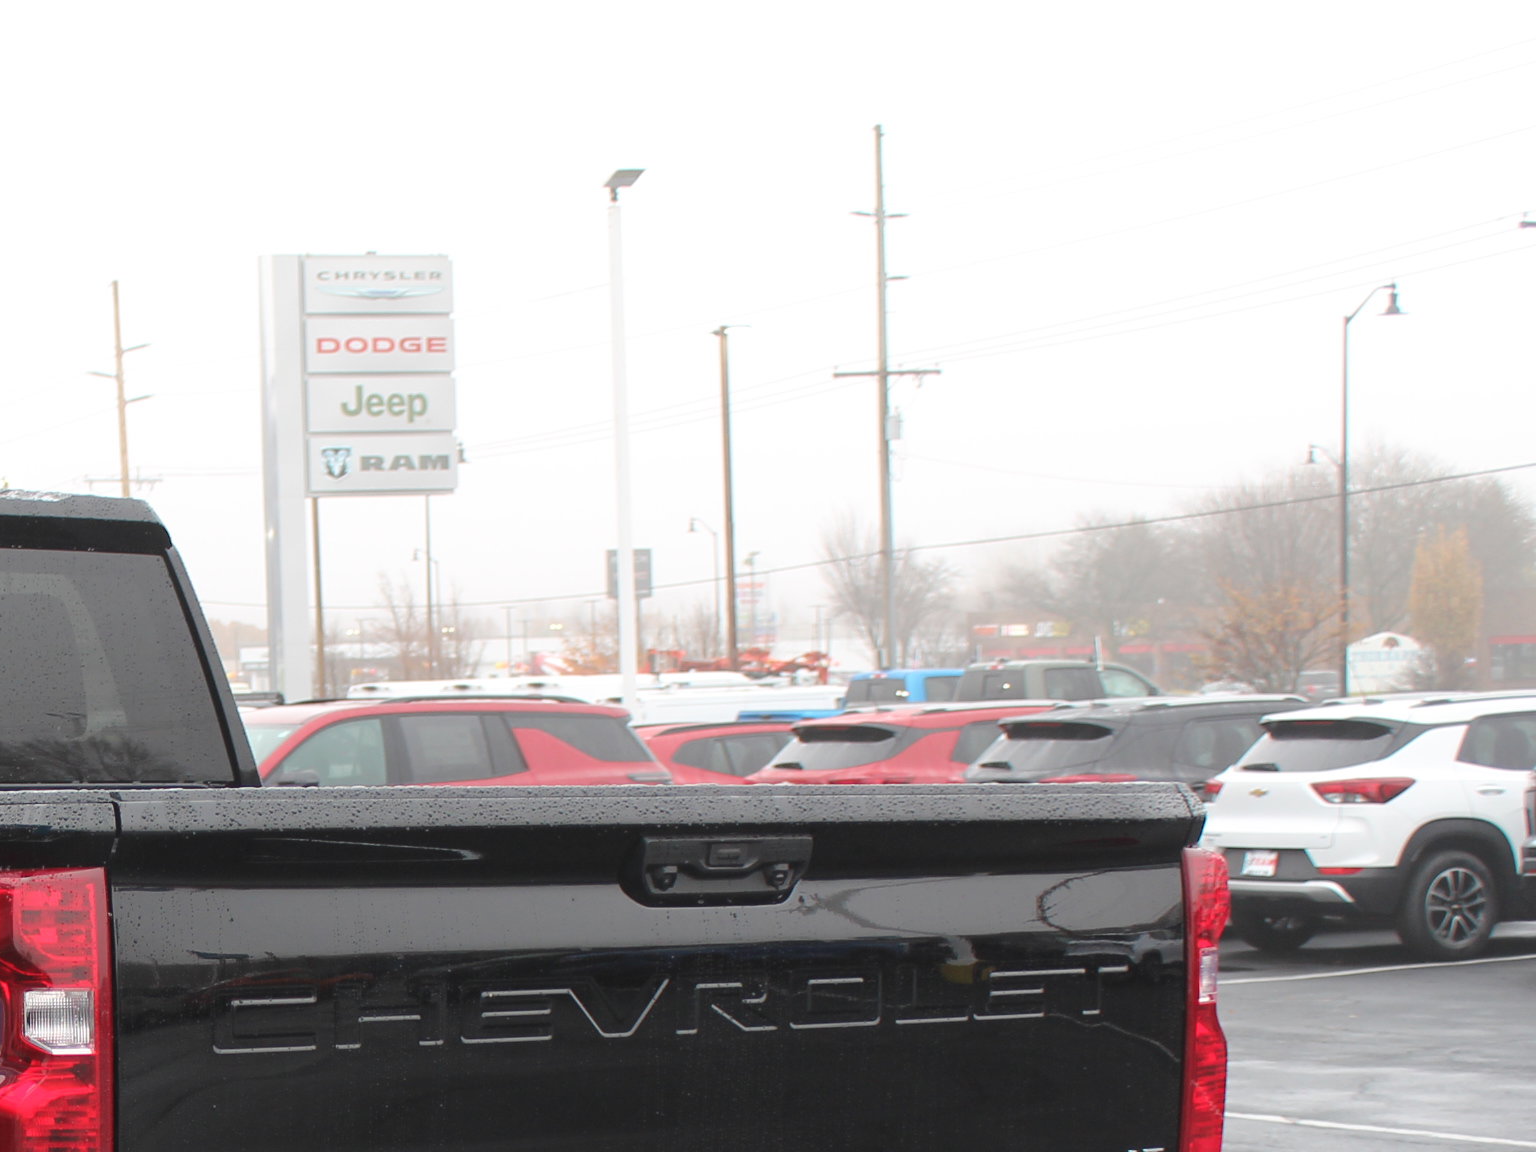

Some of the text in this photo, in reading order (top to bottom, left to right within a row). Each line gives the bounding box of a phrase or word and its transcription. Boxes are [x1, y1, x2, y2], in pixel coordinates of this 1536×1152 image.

[317, 270, 442, 281] CHRYSLER
[316, 337, 448, 354] DODGE
[340, 385, 428, 423] Jeep
[360, 454, 450, 471] RAM
[213, 957, 1130, 1054] CHEVROLET
